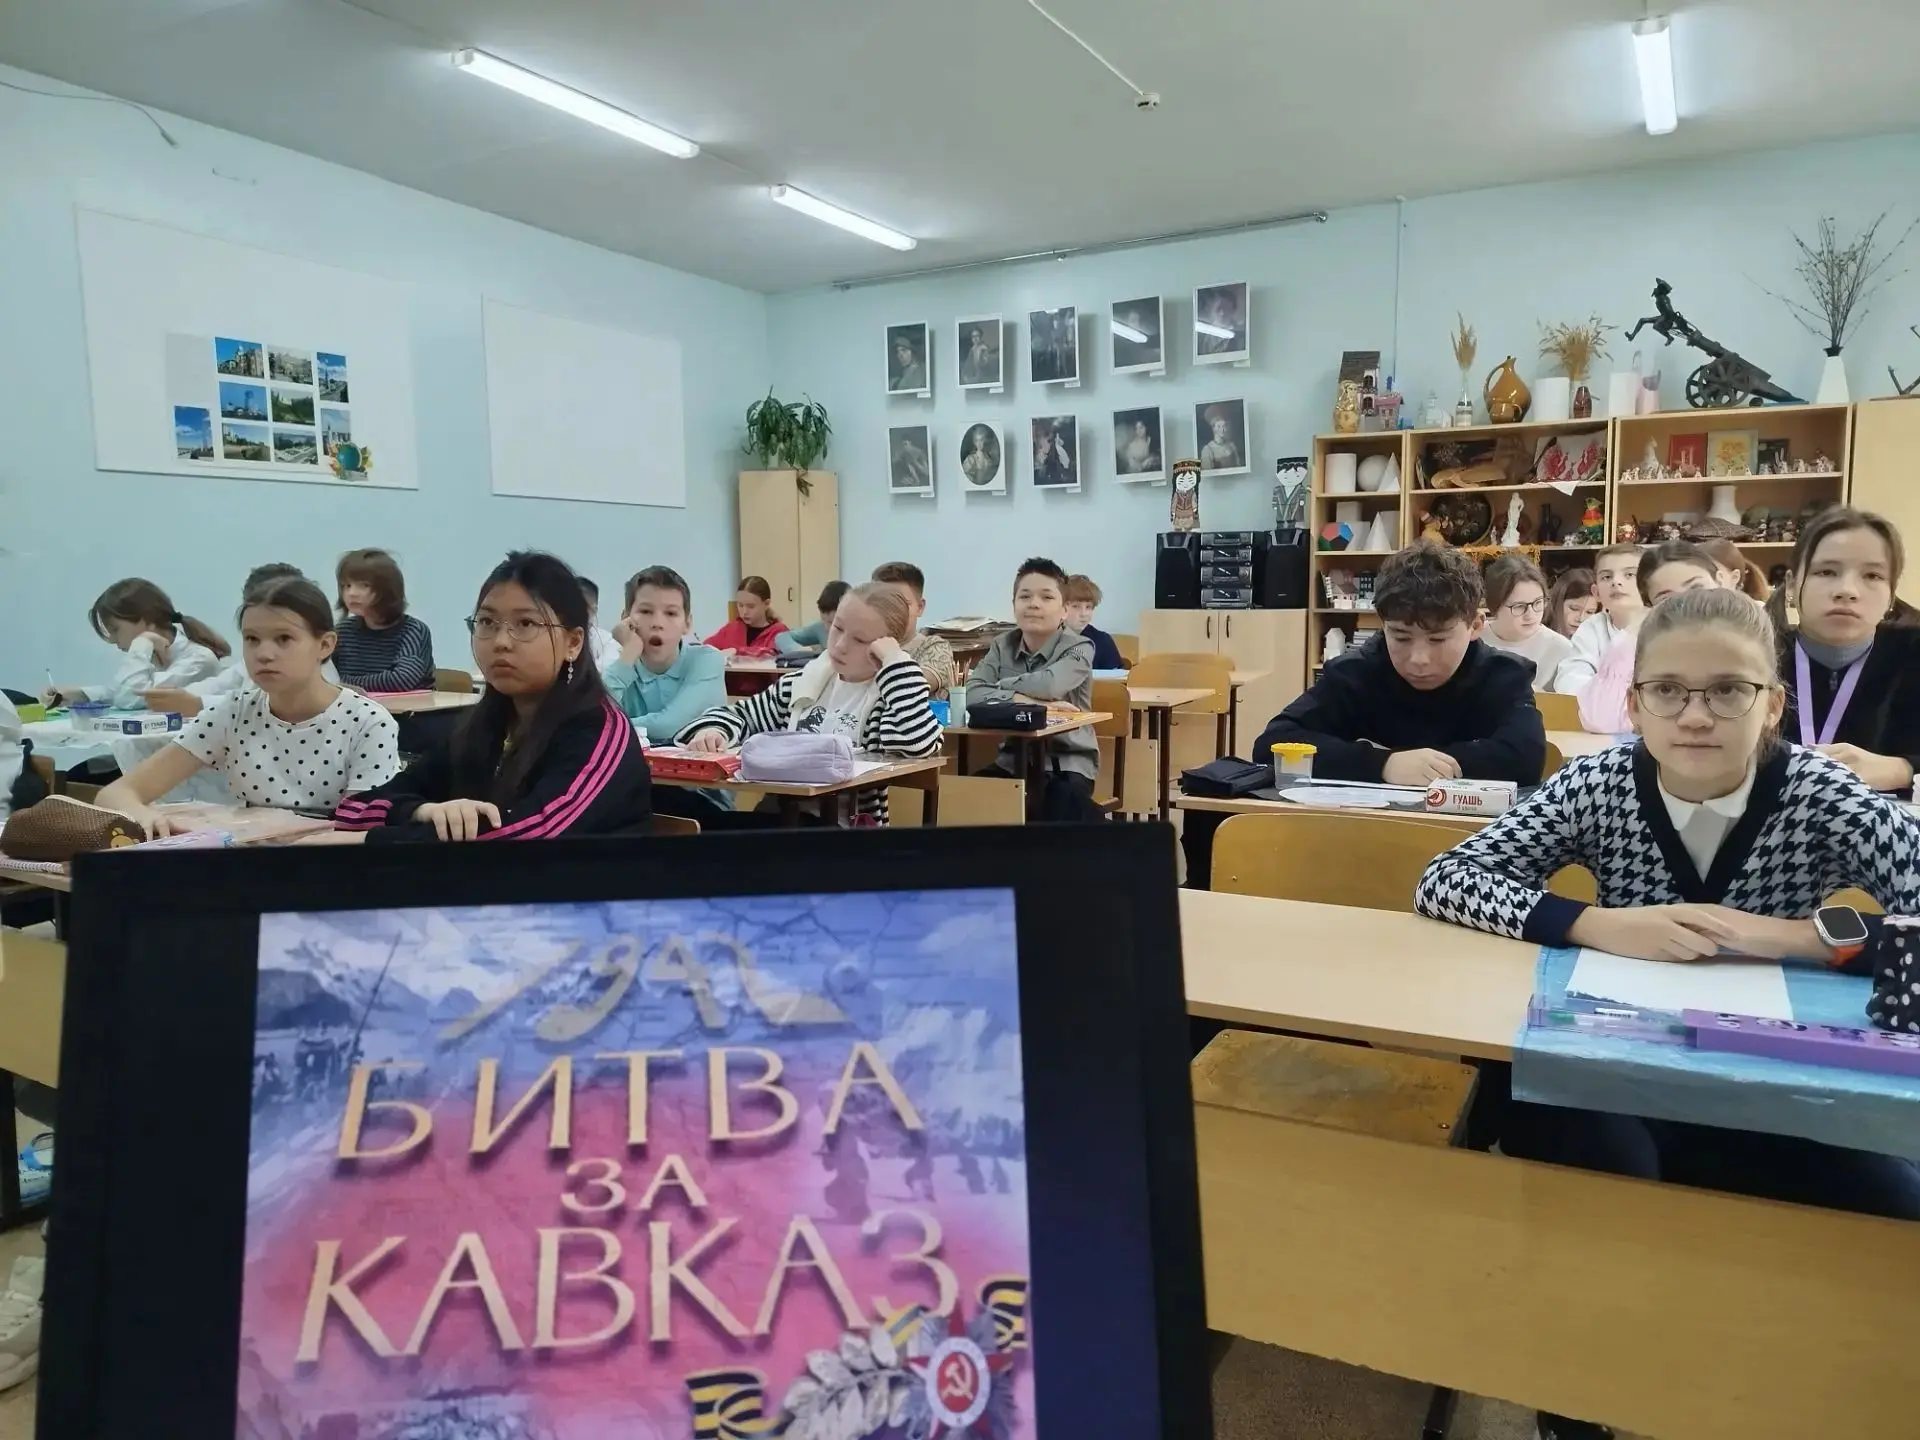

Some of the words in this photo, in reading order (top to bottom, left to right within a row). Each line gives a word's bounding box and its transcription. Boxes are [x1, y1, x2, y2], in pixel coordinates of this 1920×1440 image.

[1453, 794, 1483, 806] ГУАШЬ
[438, 930, 853, 1043] 1942
[336, 1041, 924, 1160] БИТВА
[560, 1153, 709, 1213] ЗА
[294, 1209, 960, 1365] КАВКАЗ
